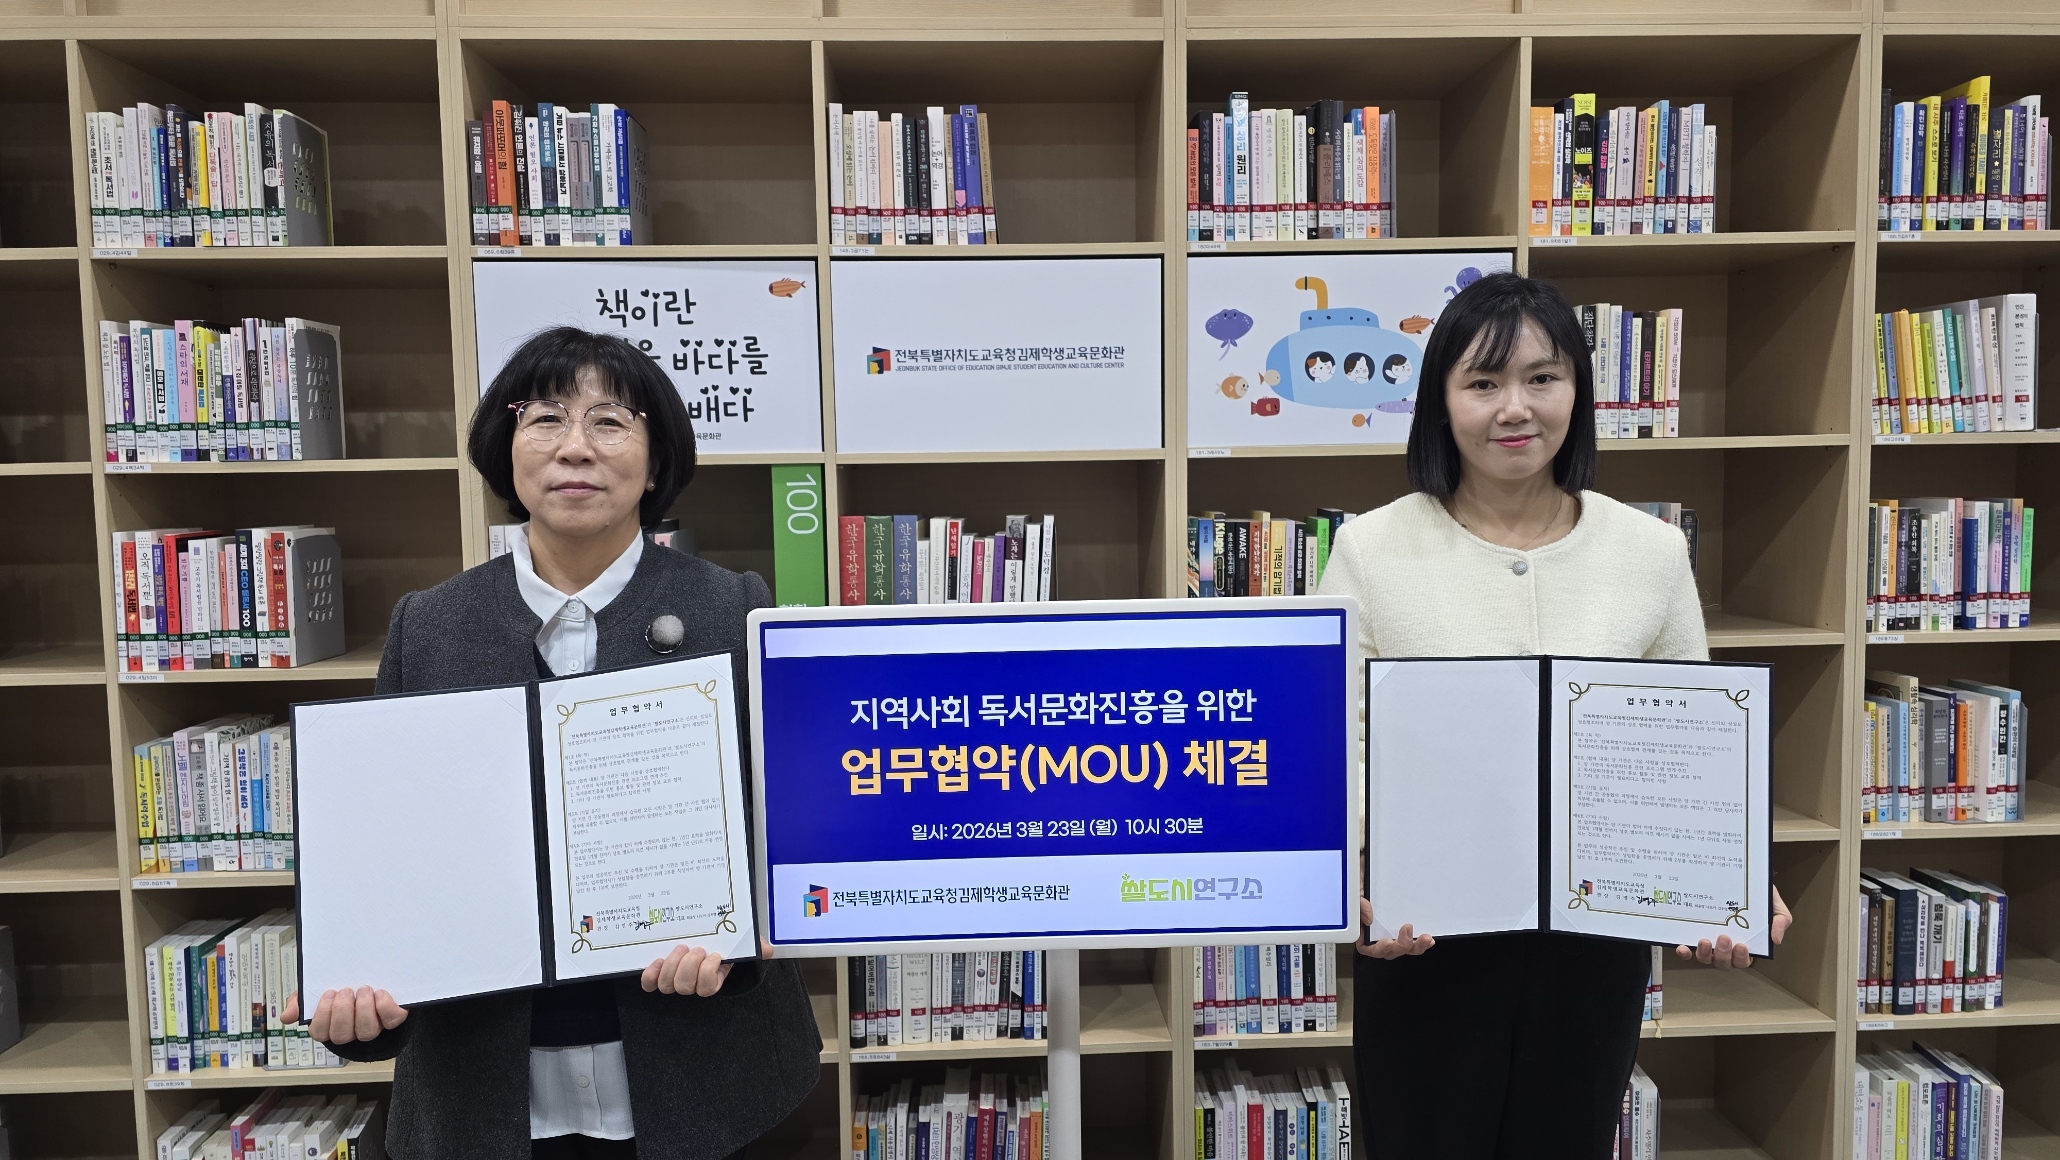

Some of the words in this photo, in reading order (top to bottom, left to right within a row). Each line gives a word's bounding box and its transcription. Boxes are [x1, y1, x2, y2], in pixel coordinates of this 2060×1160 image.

[1933, 103, 1939, 111] 내
[513, 111, 522, 133] 감춰진
[556, 113, 563, 125] 가짜
[1932, 113, 1938, 126] 사주
[265, 122, 273, 147] 치유의
[495, 110, 506, 160] 아웃퍼포머의
[557, 128, 564, 140] 뉴스
[1682, 120, 1690, 140] MBTI
[473, 136, 481, 154] 뮤지엄
[515, 134, 524, 156] 언론의
[1368, 133, 1377, 155] 도둑맞은
[1979, 134, 1987, 155] GUIDED
[1992, 129, 2002, 158] 별자리
[498, 161, 507, 170] 힘
[517, 157, 525, 172] 진실
[605, 142, 613, 172] 가짜뉴스의
[1931, 150, 1938, 163] 보기
[1978, 157, 1986, 174] TAROT
[1322, 153, 1332, 185] 폴리매스
[559, 169, 567, 195] 살아남기
[596, 288, 696, 327] 책이란
[1601, 338, 1606, 348] 나를
[179, 344, 188, 368] 스타의
[673, 336, 768, 375] 바다를
[895, 346, 1125, 362] 전북특별자치도교육청김제학생교육문화관
[248, 353, 256, 377] 리딩으로
[1643, 351, 1651, 381] 데카르트의
[180, 370, 189, 386] 서재
[1643, 383, 1650, 395] 아기
[785, 474, 819, 535] 100
[1215, 522, 1225, 554] Kluge
[240, 544, 248, 557] 세계
[1273, 546, 1283, 570] 기적의
[141, 552, 150, 570] 오직
[240, 558, 248, 570] 3대
[846, 523, 860, 600] 한국유학통사
[872, 523, 886, 600] 한국유학통사
[899, 523, 912, 600] 한국유학통사
[240, 571, 249, 588] CEO
[1273, 572, 1283, 595] 암기법
[127, 589, 136, 614] 독서법
[241, 589, 250, 609] 필독서
[243, 609, 251, 627] 100
[1910, 686, 1918, 704] 생활속
[850, 693, 970, 730] 지역사회
[979, 690, 1188, 727] 독서문화진흥을
[1196, 687, 1257, 723] 위한
[1910, 707, 1918, 725] 심리학
[178, 753, 187, 771] 노벨
[841, 739, 1168, 796] 업무협약(MOU)
[1182, 739, 1269, 788] 체결
[140, 792, 148, 812] 독서력
[197, 789, 204, 802] 사서
[141, 814, 150, 827] 수업
[197, 803, 206, 823] 읽어요
[911, 823, 949, 841] 일시:
[951, 820, 1012, 841] 2026년
[1016, 820, 1043, 839] 3월
[1047, 819, 1085, 837] 23일
[1089, 818, 1118, 837] (월)
[1125, 818, 1160, 836] 10시
[1164, 816, 1203, 836] 30분
[832, 883, 1070, 907] 전북특별자치도교육청김제학생교육문화관
[1120, 875, 1262, 903] 쌀도시연구소
[1934, 903, 1943, 921] 침묵
[1933, 925, 1943, 944] 깨기
[867, 959, 875, 984] 잃어버린
[868, 985, 875, 997] 사회
[1854, 1081, 1864, 1113] 내면소통
[1207, 1146, 1214, 1158] 마음
